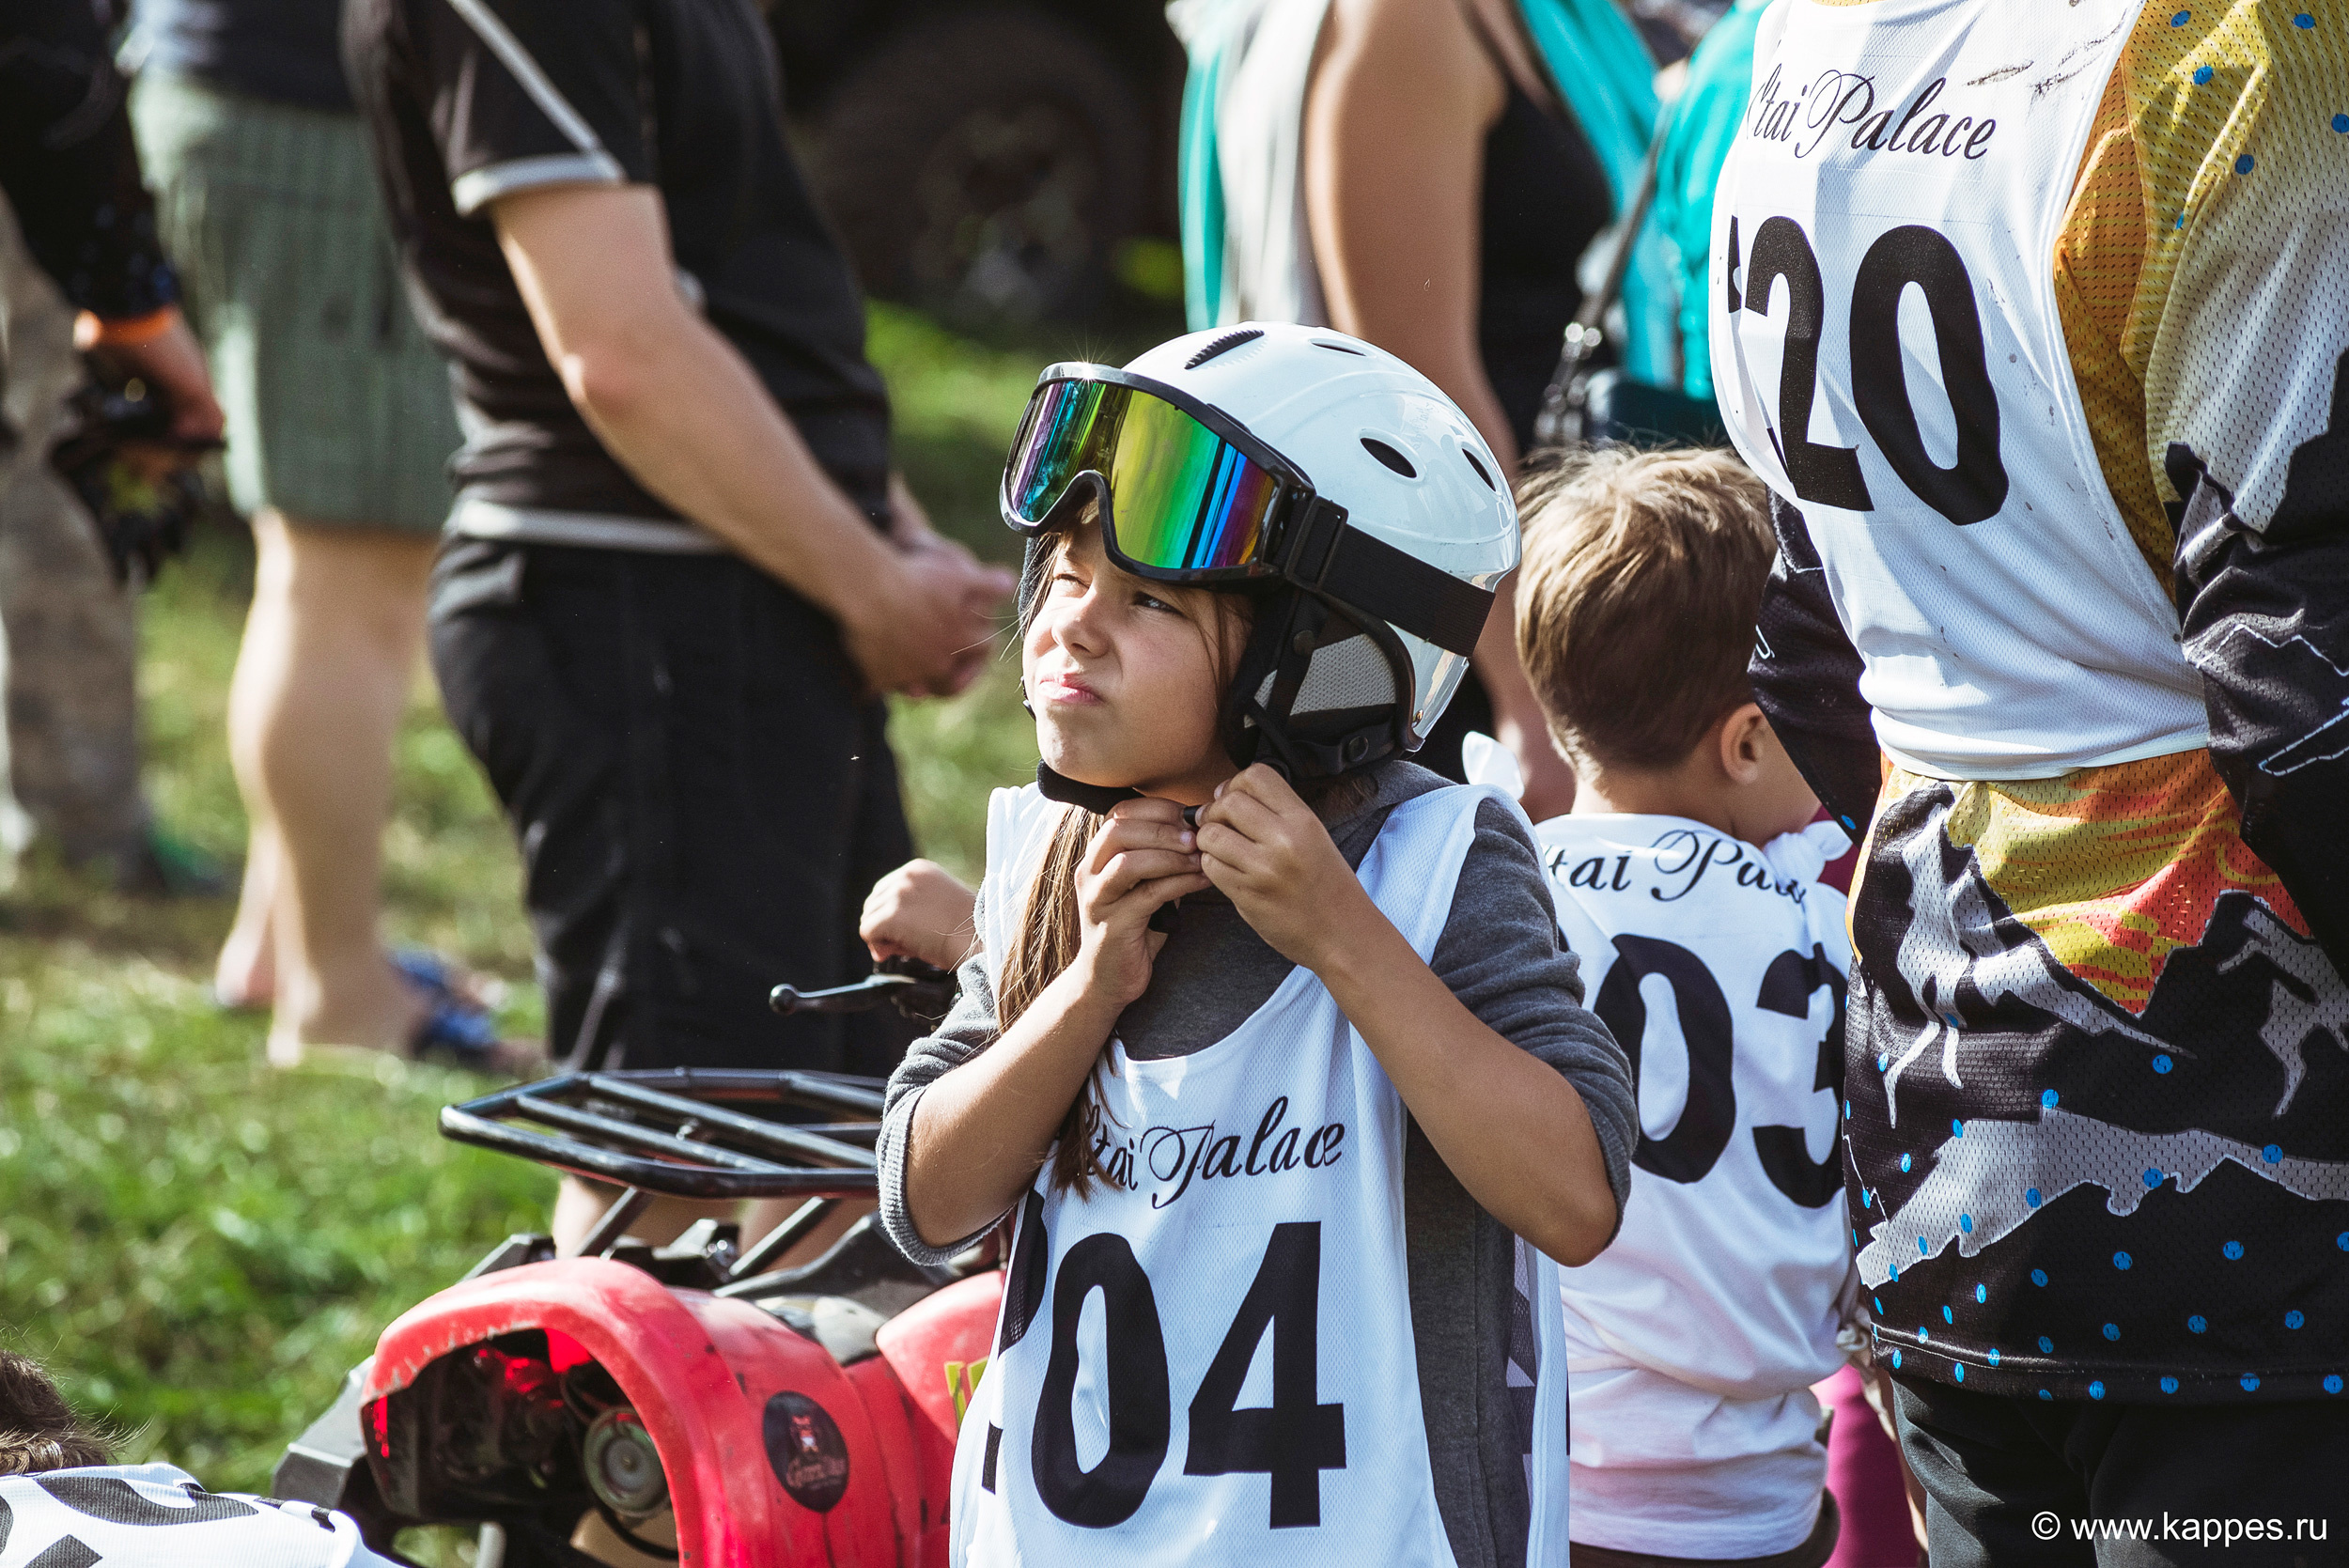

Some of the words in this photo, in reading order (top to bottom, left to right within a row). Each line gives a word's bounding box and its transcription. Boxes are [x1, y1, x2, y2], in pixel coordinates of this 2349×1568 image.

[1795, 70, 1996, 160] Palace
[1728, 214, 2010, 526] 20
[1557, 924, 1848, 1209] 03
